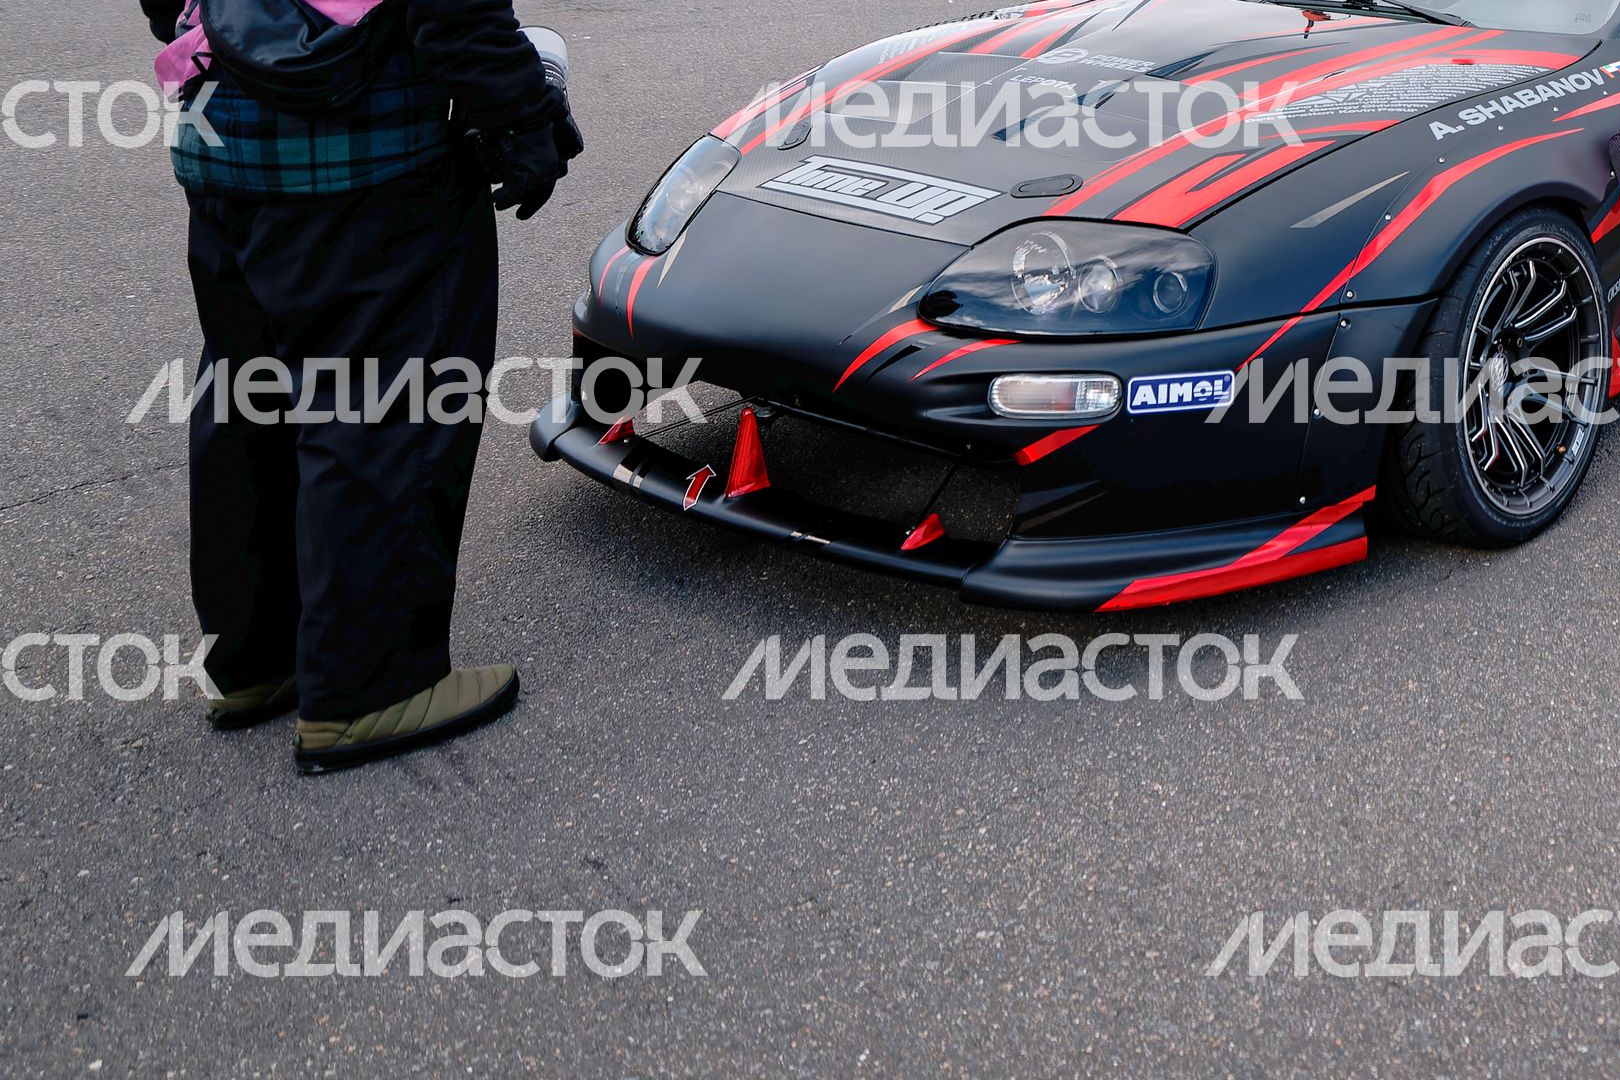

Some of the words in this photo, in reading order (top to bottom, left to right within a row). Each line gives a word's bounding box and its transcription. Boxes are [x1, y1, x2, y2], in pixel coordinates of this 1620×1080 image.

[1428, 119, 1465, 141] A.
[1457, 69, 1605, 125] SHABANOV
[1130, 378, 1230, 407] AIMOL
